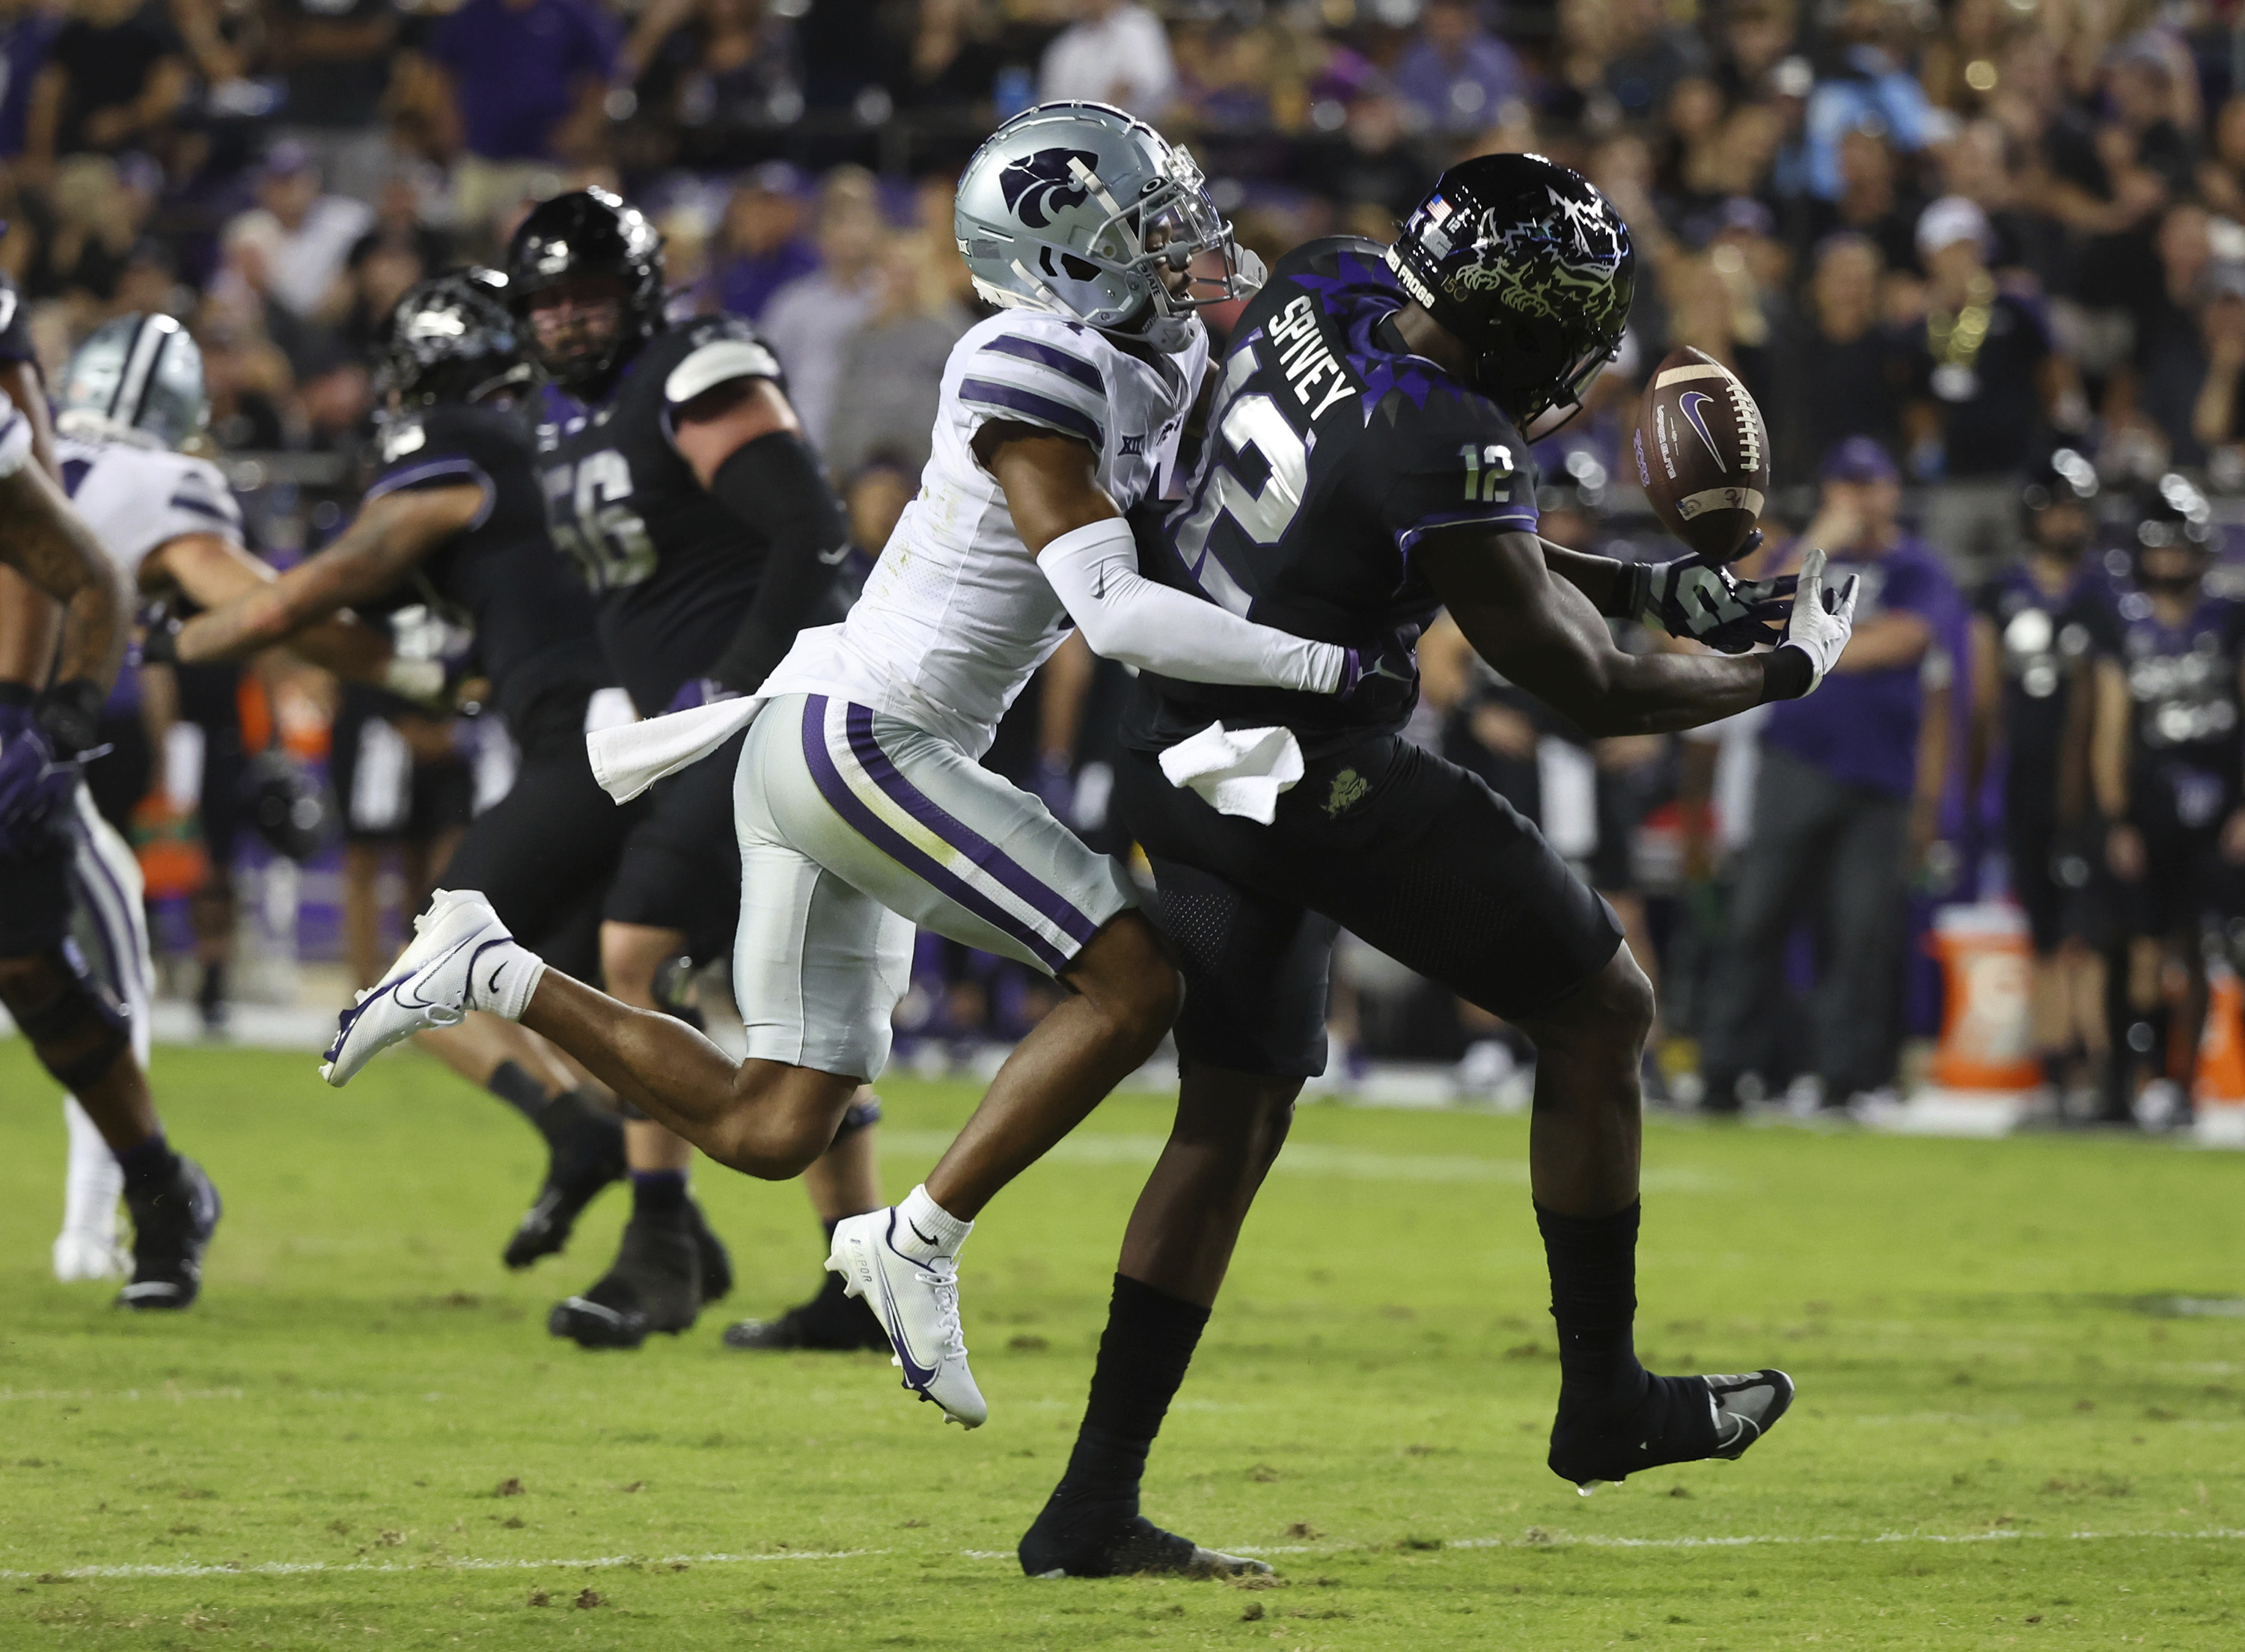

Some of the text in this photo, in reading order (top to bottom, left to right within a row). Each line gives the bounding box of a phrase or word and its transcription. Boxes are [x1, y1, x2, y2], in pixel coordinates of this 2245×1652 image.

[1397, 264, 1435, 309] FROGS
[1268, 295, 1357, 421] SPIVEY
[1164, 326, 1311, 621] 12
[1459, 444, 1514, 503] 12
